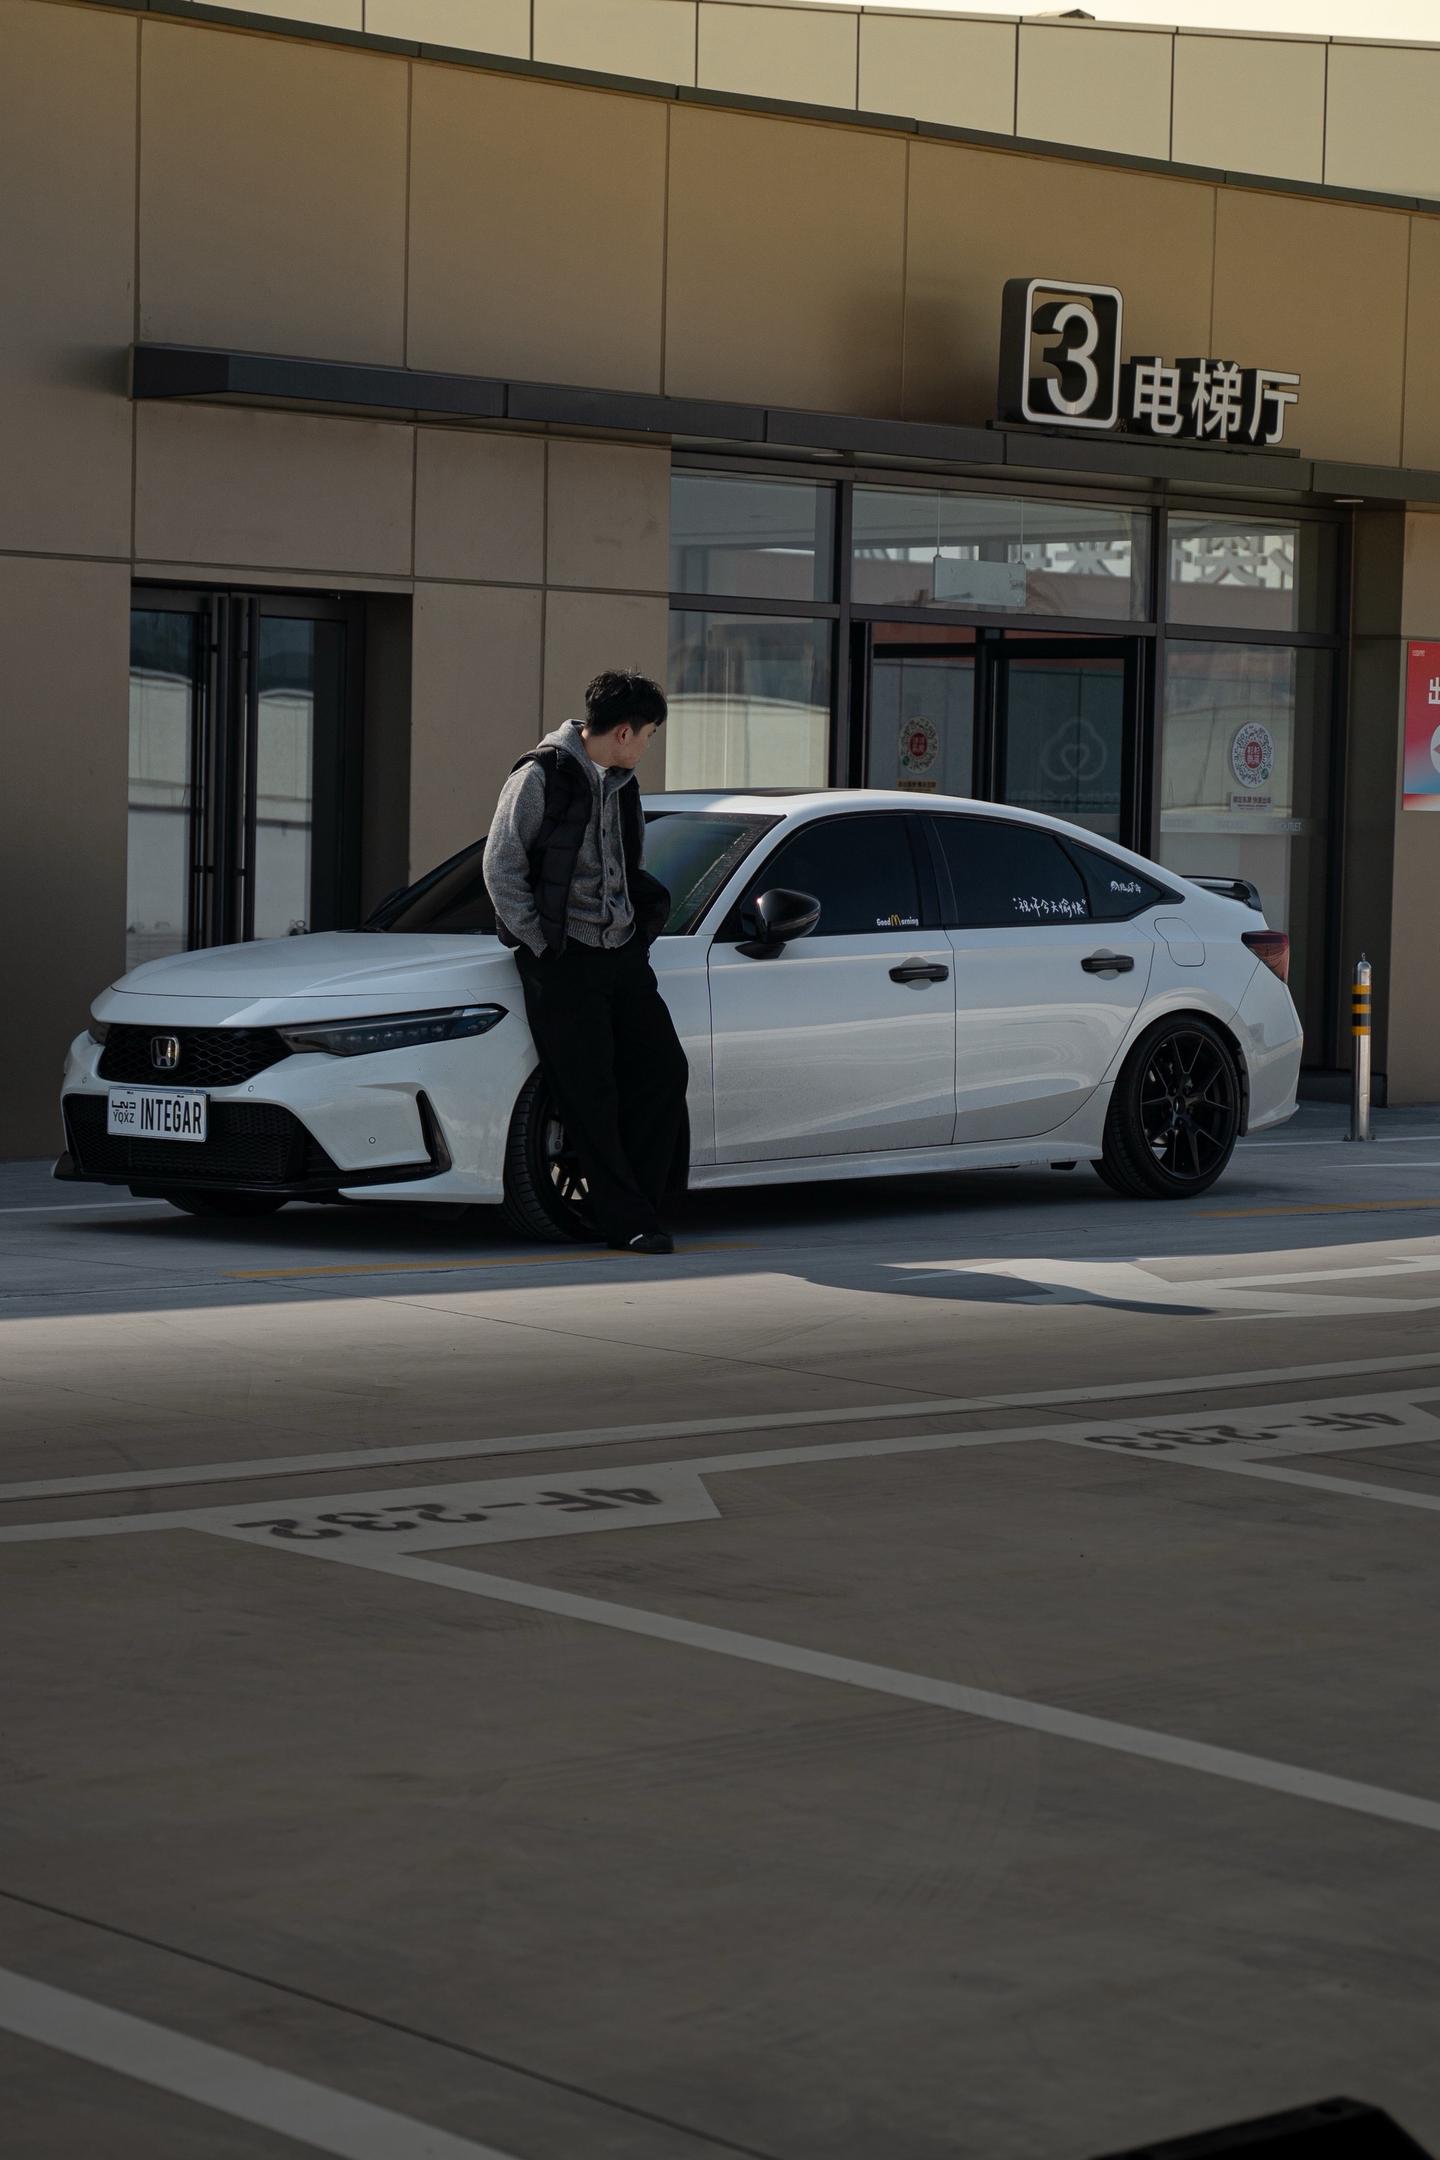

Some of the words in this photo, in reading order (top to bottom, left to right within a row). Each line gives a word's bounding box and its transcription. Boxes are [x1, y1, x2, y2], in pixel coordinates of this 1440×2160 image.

[1047, 303, 1099, 415] 3
[1132, 357, 1301, 444] 电梯厅
[113, 1112, 135, 1124] YQXZ
[141, 1098, 202, 1134] INTEGAR
[1084, 1412, 1406, 1452] 4F-233
[232, 1488, 663, 1541] 4F-232
